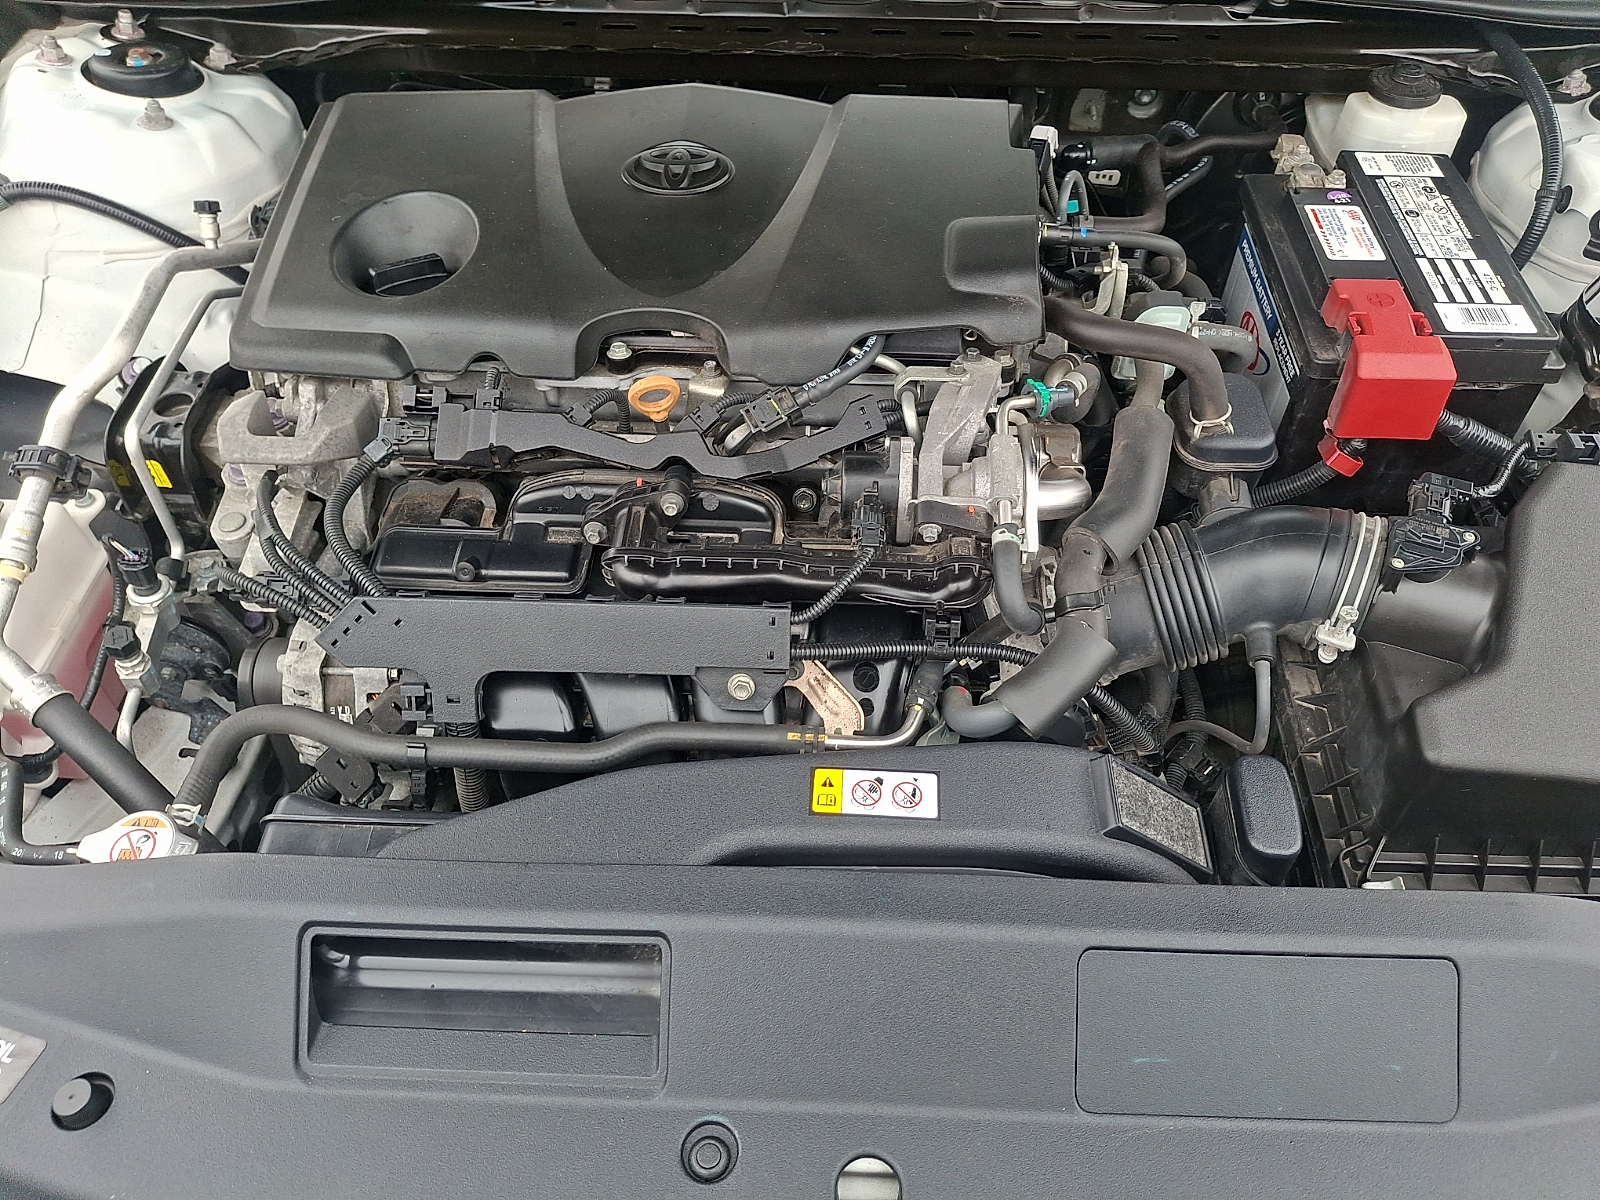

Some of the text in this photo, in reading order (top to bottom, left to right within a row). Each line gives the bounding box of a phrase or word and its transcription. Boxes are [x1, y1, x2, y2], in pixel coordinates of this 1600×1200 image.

[1242, 238, 1273, 321] PREMIUM BATTERY
[1276, 335, 1288, 359] YEAR
[1285, 357, 1296, 378] FREE
[54, 850, 64, 860] 18
